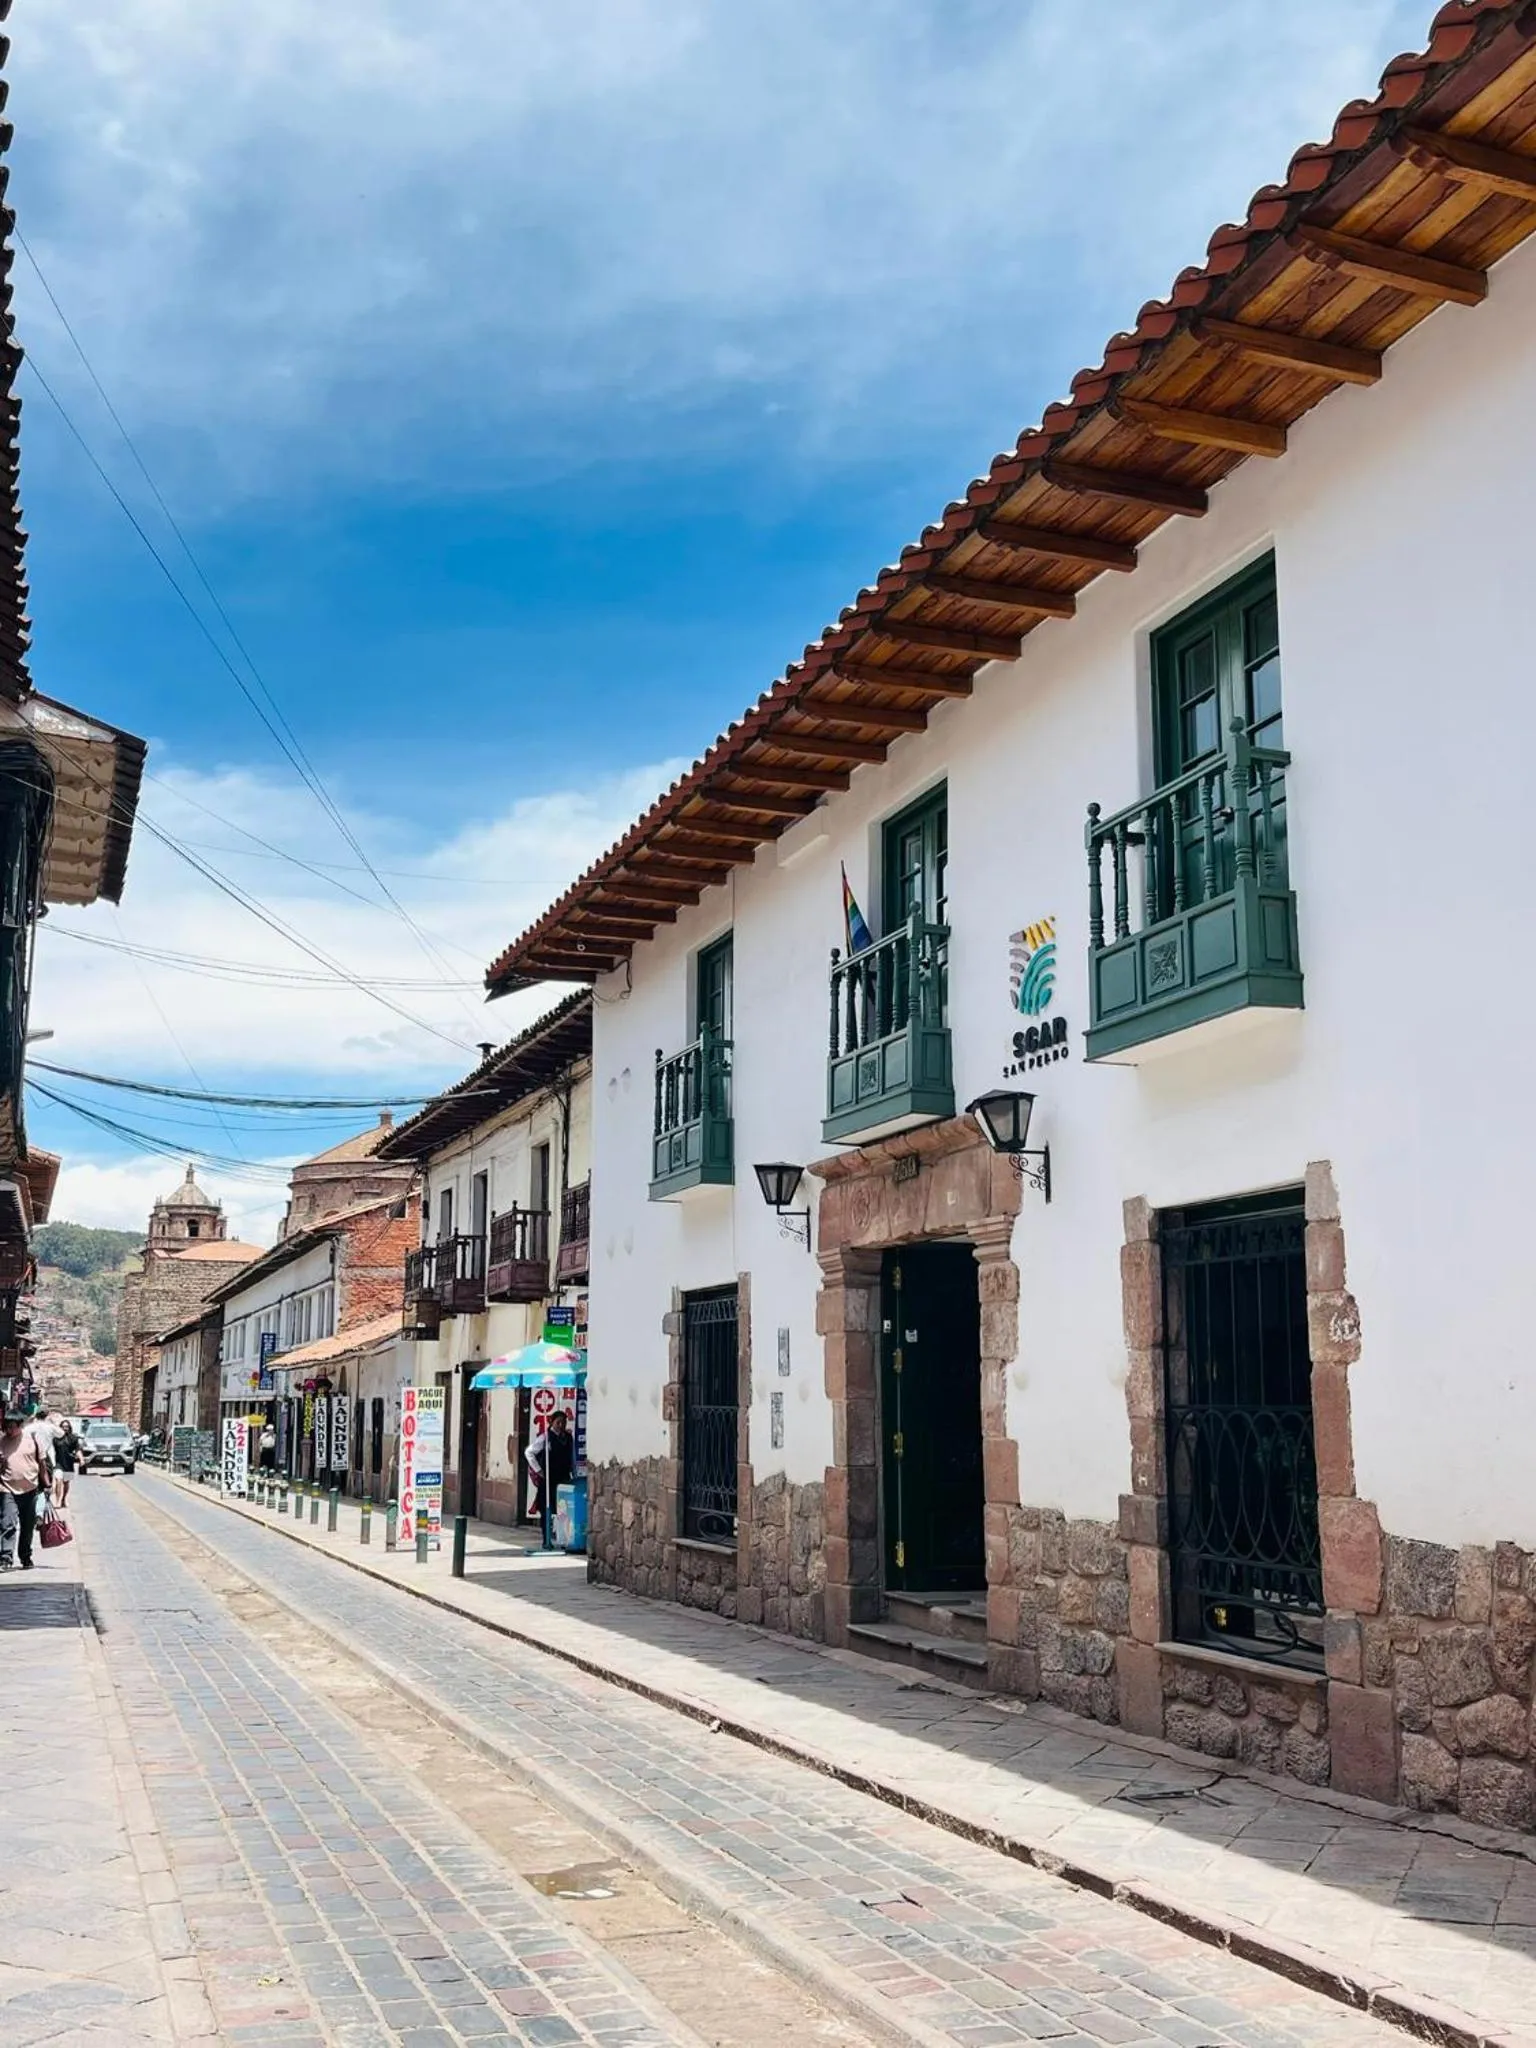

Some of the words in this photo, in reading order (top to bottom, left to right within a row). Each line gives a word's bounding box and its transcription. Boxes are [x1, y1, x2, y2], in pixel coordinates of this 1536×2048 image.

[1003, 1060, 1026, 1079] SAN
[418, 1389, 443, 1398] PAGUE
[418, 1399, 443, 1410] AQUI
[224, 1420, 236, 1490] LAUNDRY
[317, 1399, 325, 1458] LAUNDRY
[335, 1399, 347, 1460] LAUNDRY
[401, 1390, 416, 1539] BOTICA
